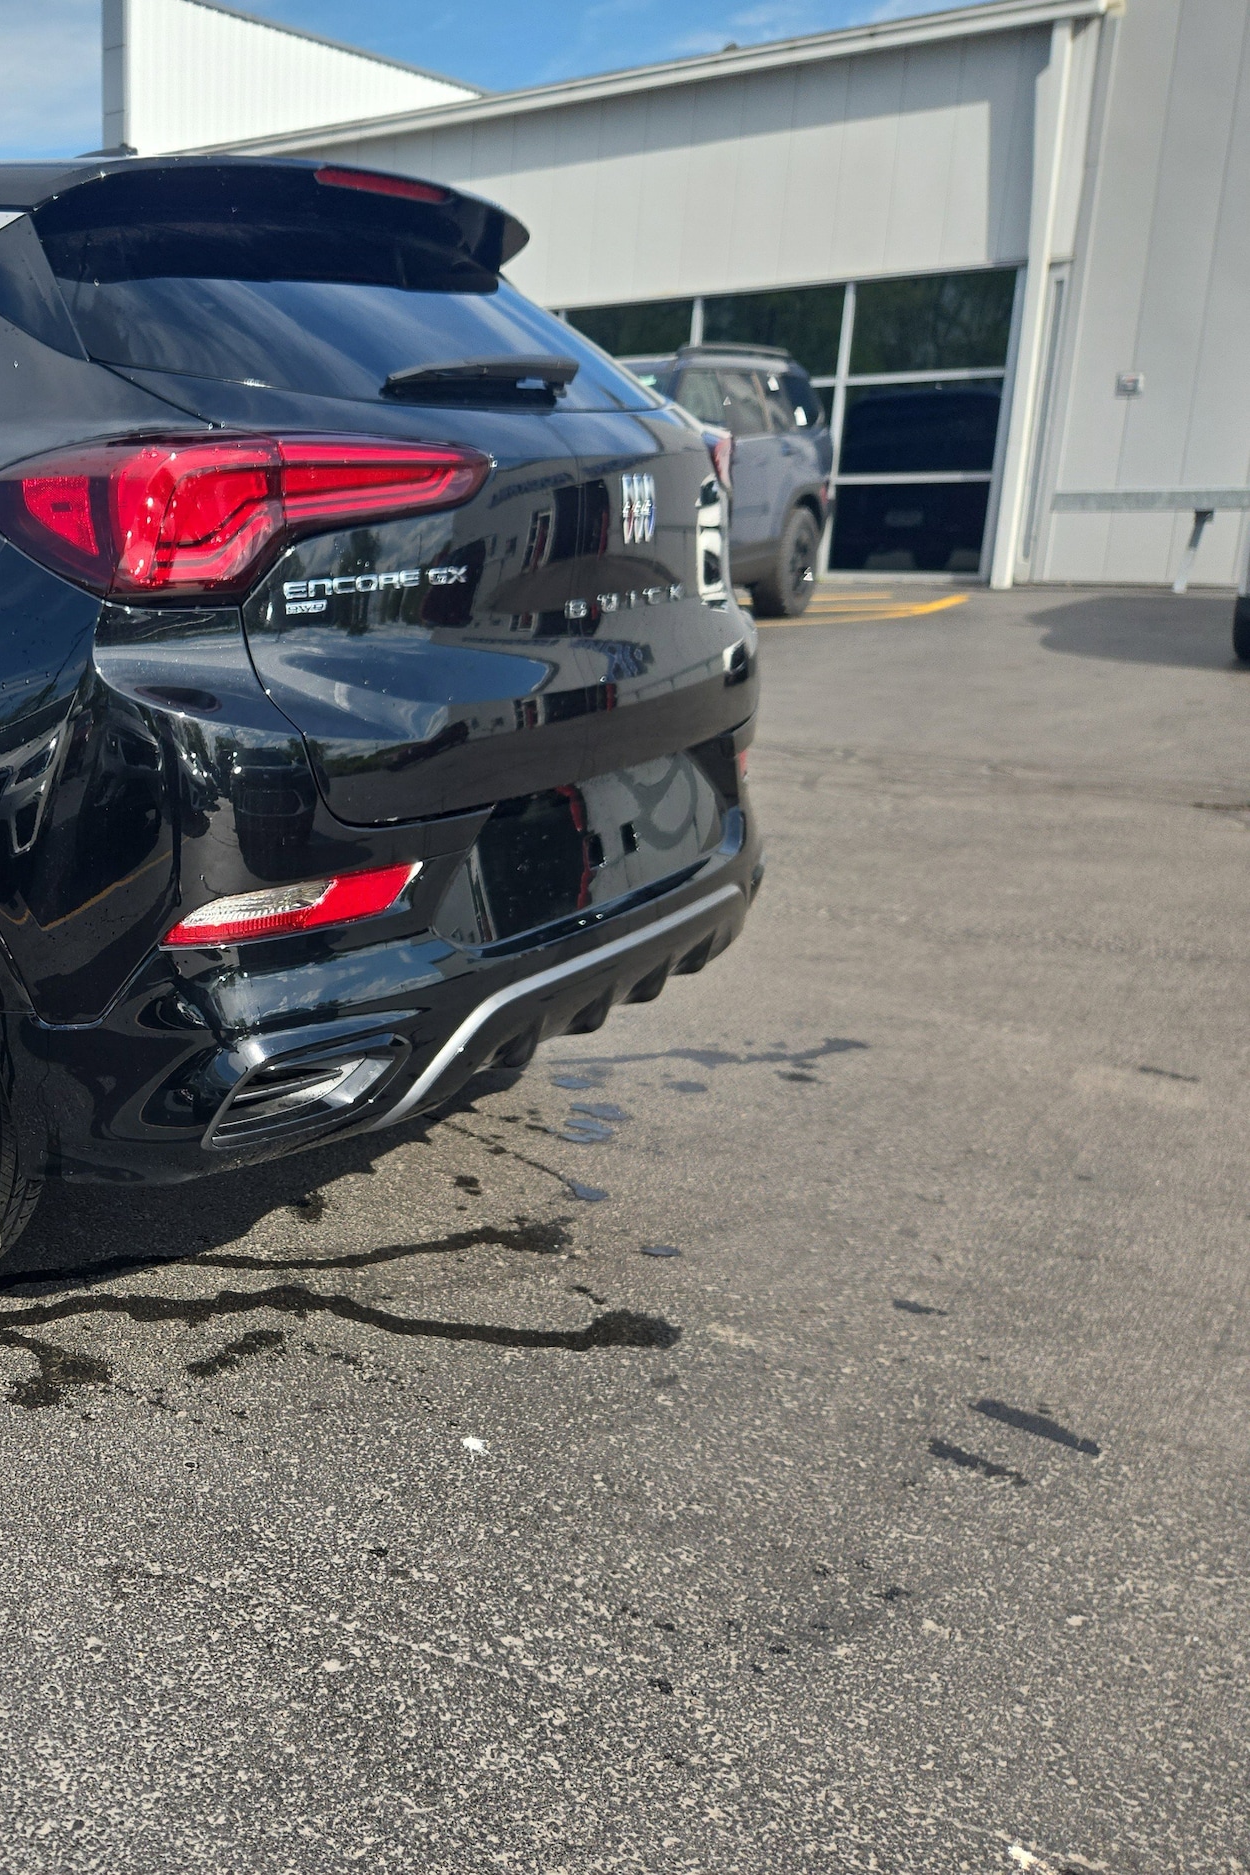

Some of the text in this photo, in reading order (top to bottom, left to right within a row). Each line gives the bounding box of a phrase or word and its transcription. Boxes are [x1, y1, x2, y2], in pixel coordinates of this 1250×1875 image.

[283, 565, 468, 599] ENCORE GX
[564, 583, 685, 619] BUICK
